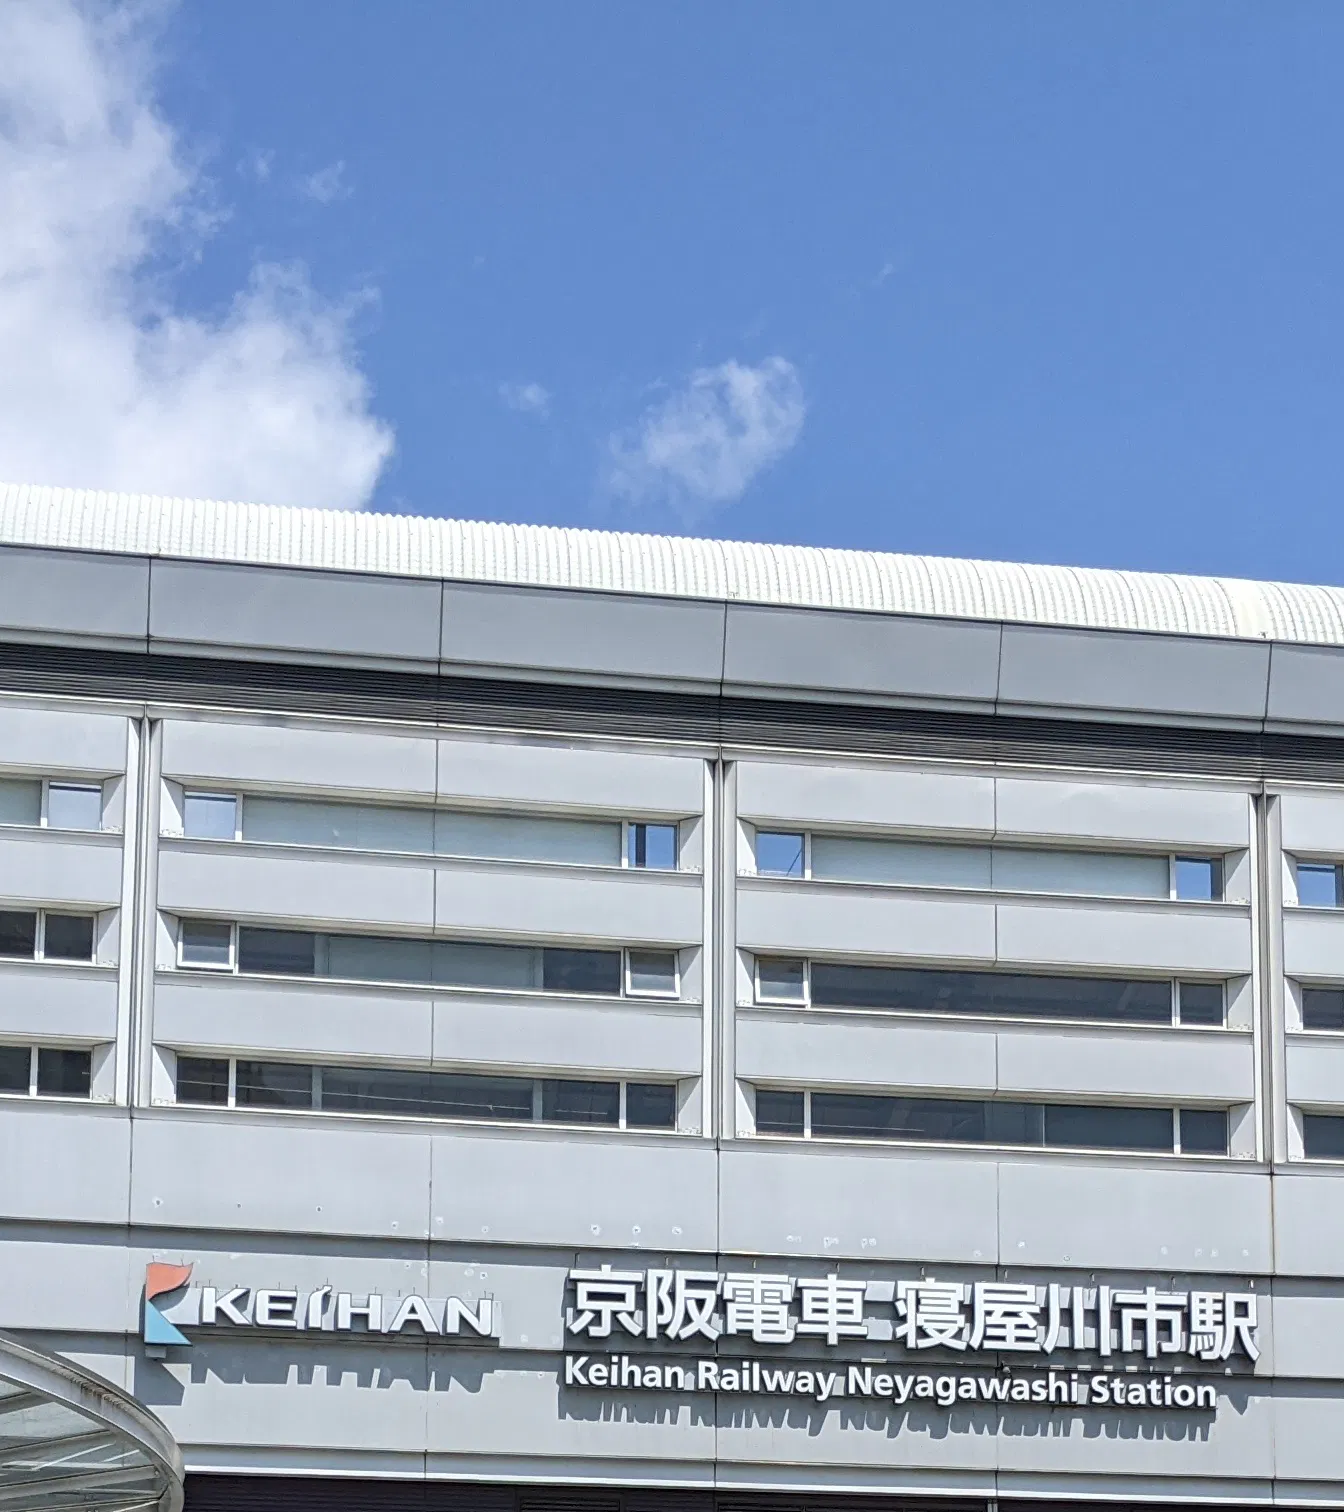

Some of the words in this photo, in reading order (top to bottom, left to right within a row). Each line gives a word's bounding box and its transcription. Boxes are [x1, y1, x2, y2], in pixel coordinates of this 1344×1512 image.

[199, 1284, 493, 1337] KEIHAN
[568, 1264, 868, 1347] 京阪電車
[894, 1277, 1261, 1361] 寝屋川市駅
[565, 1355, 685, 1390] Keihan
[697, 1360, 835, 1402] Railway
[847, 1366, 1079, 1406] Neyagawashi
[1090, 1375, 1217, 1407] Station
